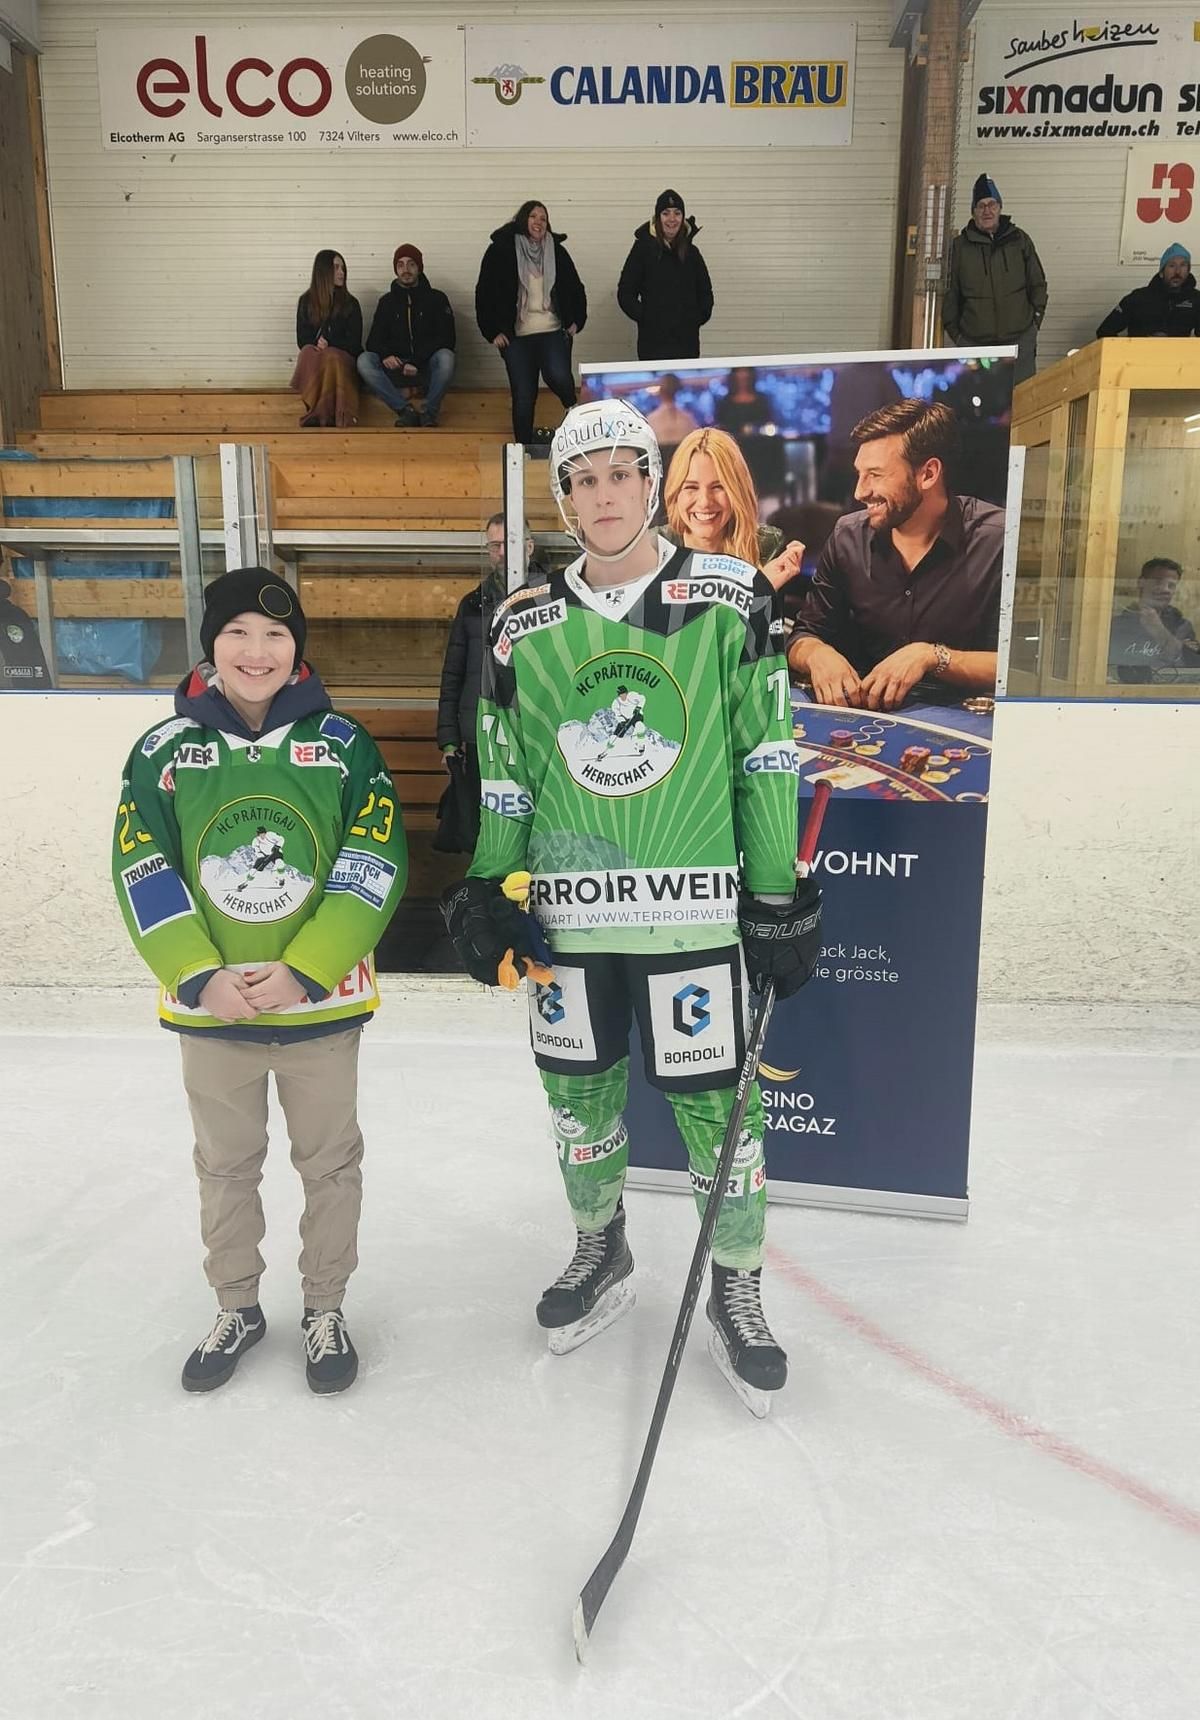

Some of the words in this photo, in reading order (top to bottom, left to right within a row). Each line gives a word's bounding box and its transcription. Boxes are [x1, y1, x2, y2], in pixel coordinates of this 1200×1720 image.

[136, 35, 333, 118] elco
[359, 64, 412, 81] heating
[355, 80, 417, 97] solutions
[550, 65, 726, 105] CALANDA
[734, 64, 844, 105] BRÄU
[977, 74, 1163, 114] sixmadun
[110, 131, 165, 143] Elcotherm
[168, 132, 185, 143] AG
[196, 131, 284, 144] Sarganserstrasse
[288, 131, 306, 142] 100
[319, 131, 344, 142] 7324
[347, 130, 380, 142] Vilters
[393, 130, 458, 142] www.elco.ch
[976, 120, 1160, 138] www.sixmadun.ch
[576, 676, 595, 697] HC
[594, 662, 661, 689] PRÄTTIGAU
[581, 759, 655, 787] HERRSCHAFT
[480, 791, 533, 815] DES
[216, 820, 235, 835] HC
[232, 806, 296, 832] PRÄTTIGAU
[124, 856, 168, 886] TRUMP
[222, 891, 293, 915] HERRSCHAFT
[850, 945, 891, 964] Jack,
[812, 963, 830, 978] ie
[835, 965, 899, 983] grösste
[536, 1031, 584, 1050] BORDOLI
[664, 1045, 725, 1064] BORDOLI
[761, 1089, 815, 1111] SINO
[762, 1113, 836, 1136] RAGAZ
